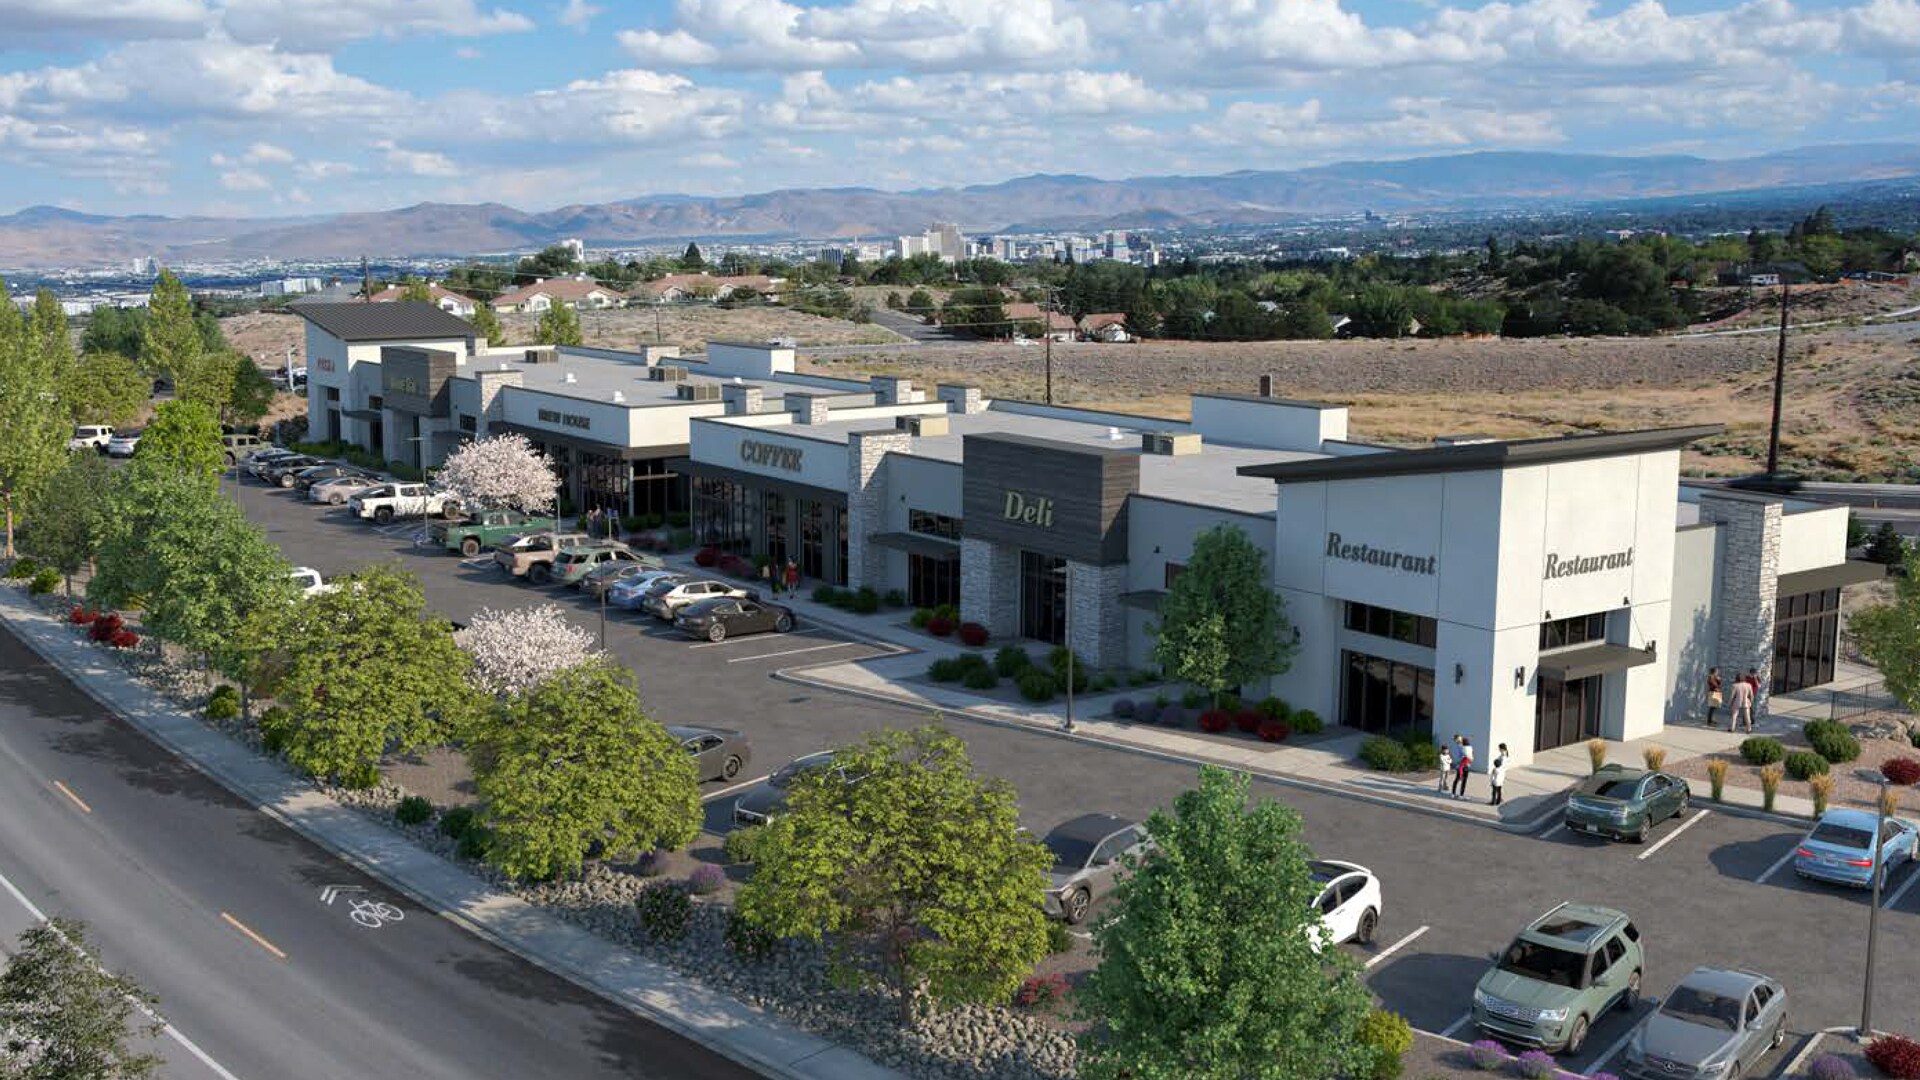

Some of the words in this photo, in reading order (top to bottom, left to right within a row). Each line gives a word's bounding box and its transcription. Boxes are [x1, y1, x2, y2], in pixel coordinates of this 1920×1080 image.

[741, 439, 803, 473] COFFEE
[1004, 491, 1054, 527] Deli
[1327, 532, 1436, 575] Restaurant
[1542, 546, 1633, 580] Restaurant
